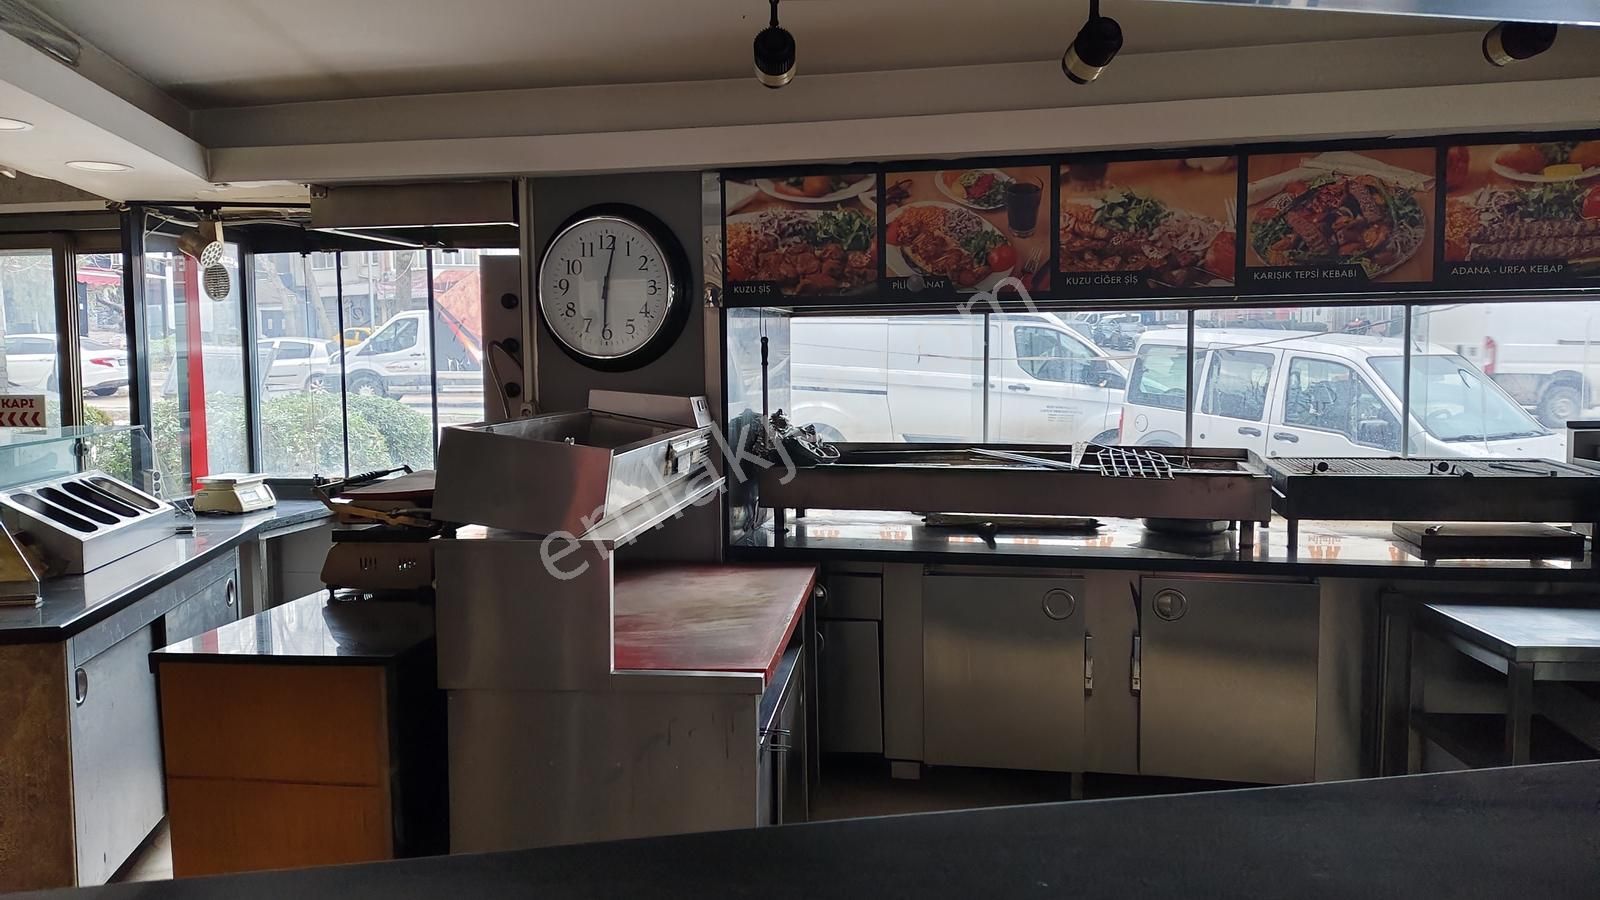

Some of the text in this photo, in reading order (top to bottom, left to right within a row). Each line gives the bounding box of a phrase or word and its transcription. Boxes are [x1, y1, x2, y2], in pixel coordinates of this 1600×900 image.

[581, 242, 594, 257] 11
[599, 235, 616, 250] 12
[626, 240, 631, 256] 1
[566, 259, 583, 275] 10
[638, 255, 649, 271] 2
[1451, 266, 1491, 275] ADANA
[1499, 265, 1527, 274] URFA
[1529, 264, 1563, 273] KEBAP
[1066, 273, 1138, 286] KUZU CİĞER ŞİŞ
[1253, 268, 1357, 280] KARIŞIK TEPSİ KEBABI
[558, 278, 569, 296] 9
[647, 279, 658, 296] 3
[733, 283, 771, 295] KUZU ŞİŞ
[892, 279, 911, 289] PİLİ
[565, 302, 576, 317] 8
[639, 302, 650, 317] 4
[583, 318, 593, 333] 7
[601, 323, 613, 340] 6
[625, 318, 636, 334] 5
[1, 398, 35, 408] KAPI
